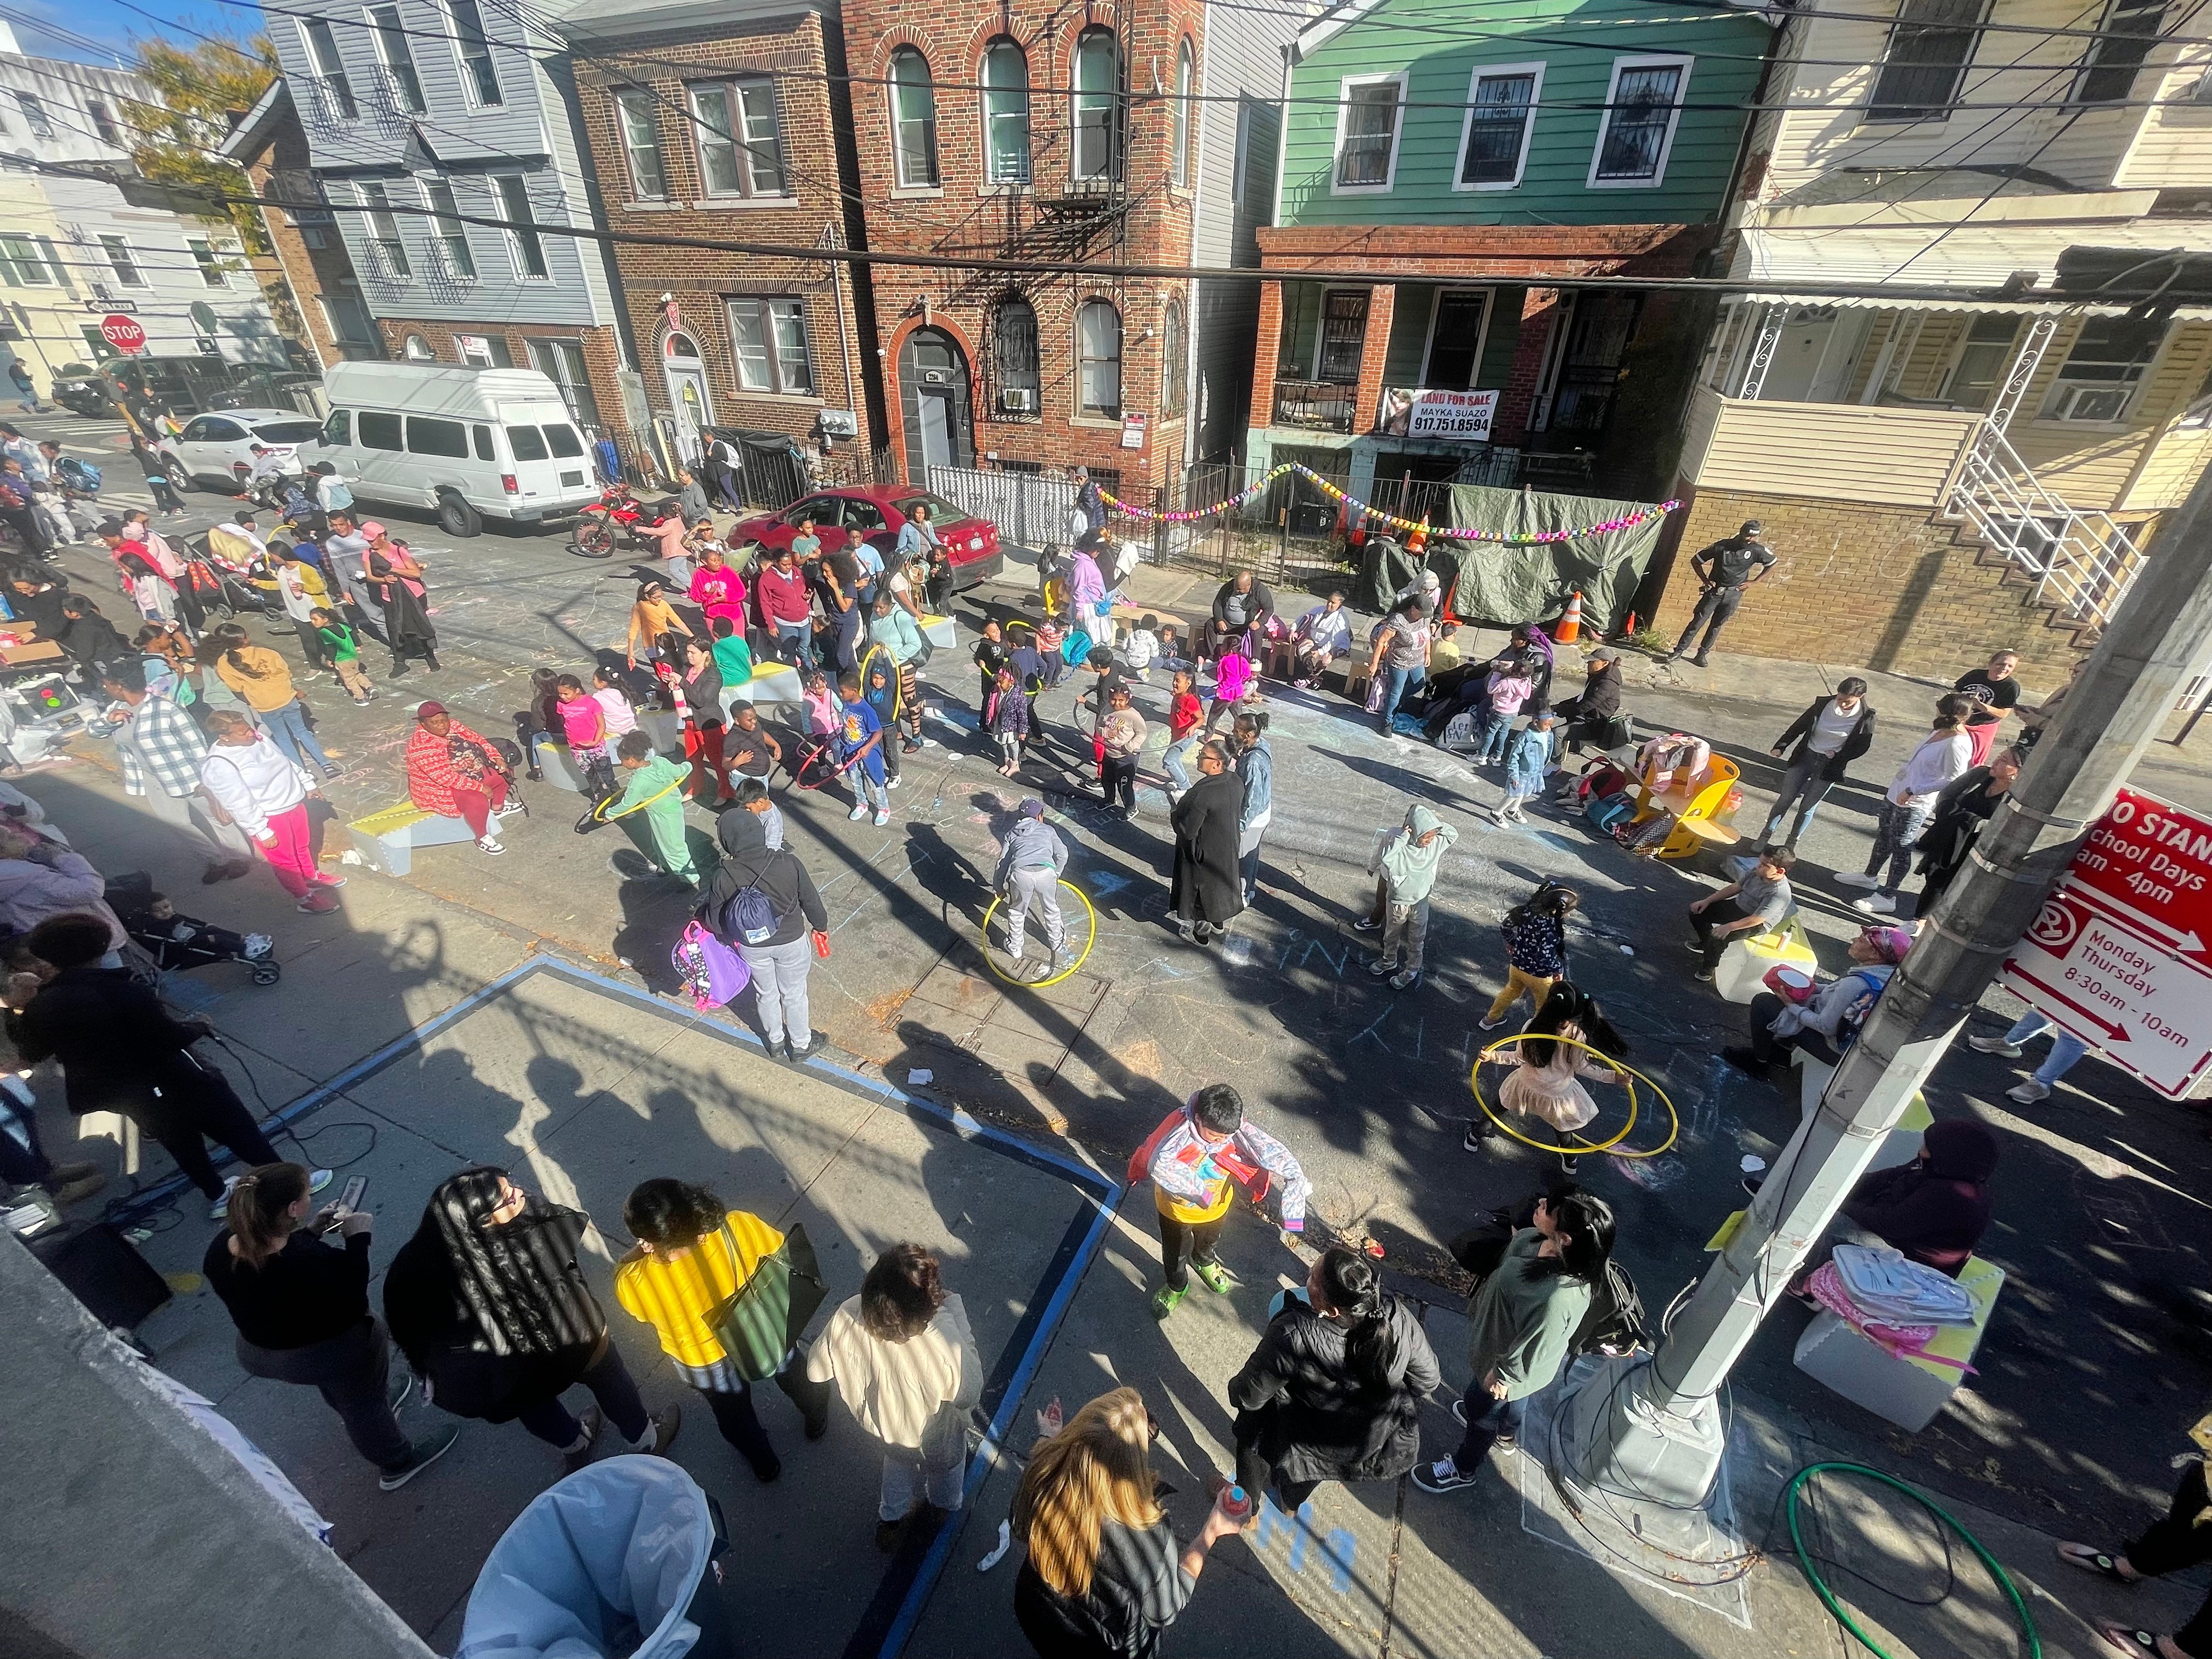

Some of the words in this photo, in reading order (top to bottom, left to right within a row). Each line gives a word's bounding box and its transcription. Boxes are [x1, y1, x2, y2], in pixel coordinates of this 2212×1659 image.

[104, 325, 140, 340] STOP
[1420, 408, 1452, 417] MAYKA
[1455, 409, 1487, 417] SUAZO
[1421, 393, 1446, 405] LAND
[1447, 394, 1465, 405] FOR
[1467, 394, 1491, 407] SALE
[1414, 417, 1489, 432] 917.751.8594
[900, 663, 916, 702] LOVE
[2108, 798, 2136, 825] O
[2137, 812, 2212, 866] STAN
[2076, 849, 2108, 871] am
[2125, 871, 2174, 904] 4pm
[2090, 829, 2151, 863] chool
[2149, 853, 2208, 890] Days
[2081, 945, 2158, 997] Thursday
[2089, 930, 2157, 975] Monday
[2064, 967, 2126, 1011] 8:30am
[2140, 1012, 2189, 1048] 10am
